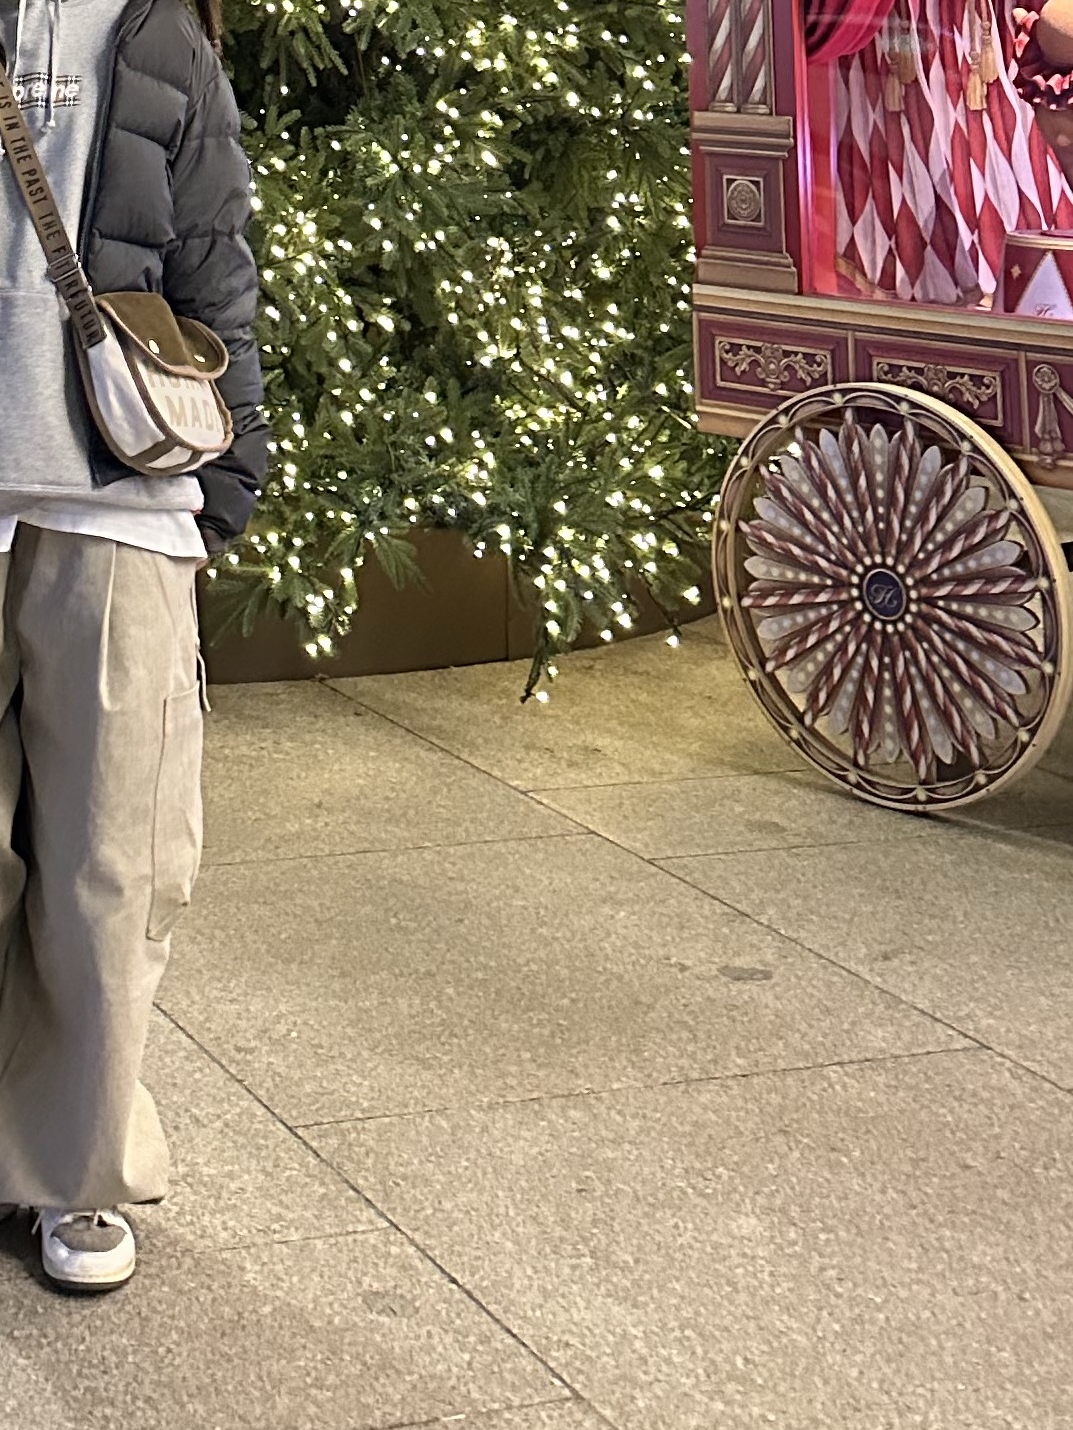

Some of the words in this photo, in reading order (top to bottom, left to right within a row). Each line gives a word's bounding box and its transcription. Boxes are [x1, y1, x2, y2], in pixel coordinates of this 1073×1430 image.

[3, 115, 20, 131] IN
[10, 136, 33, 164] THE
[21, 168, 48, 205] PAST
[38, 212, 61, 241] THE
